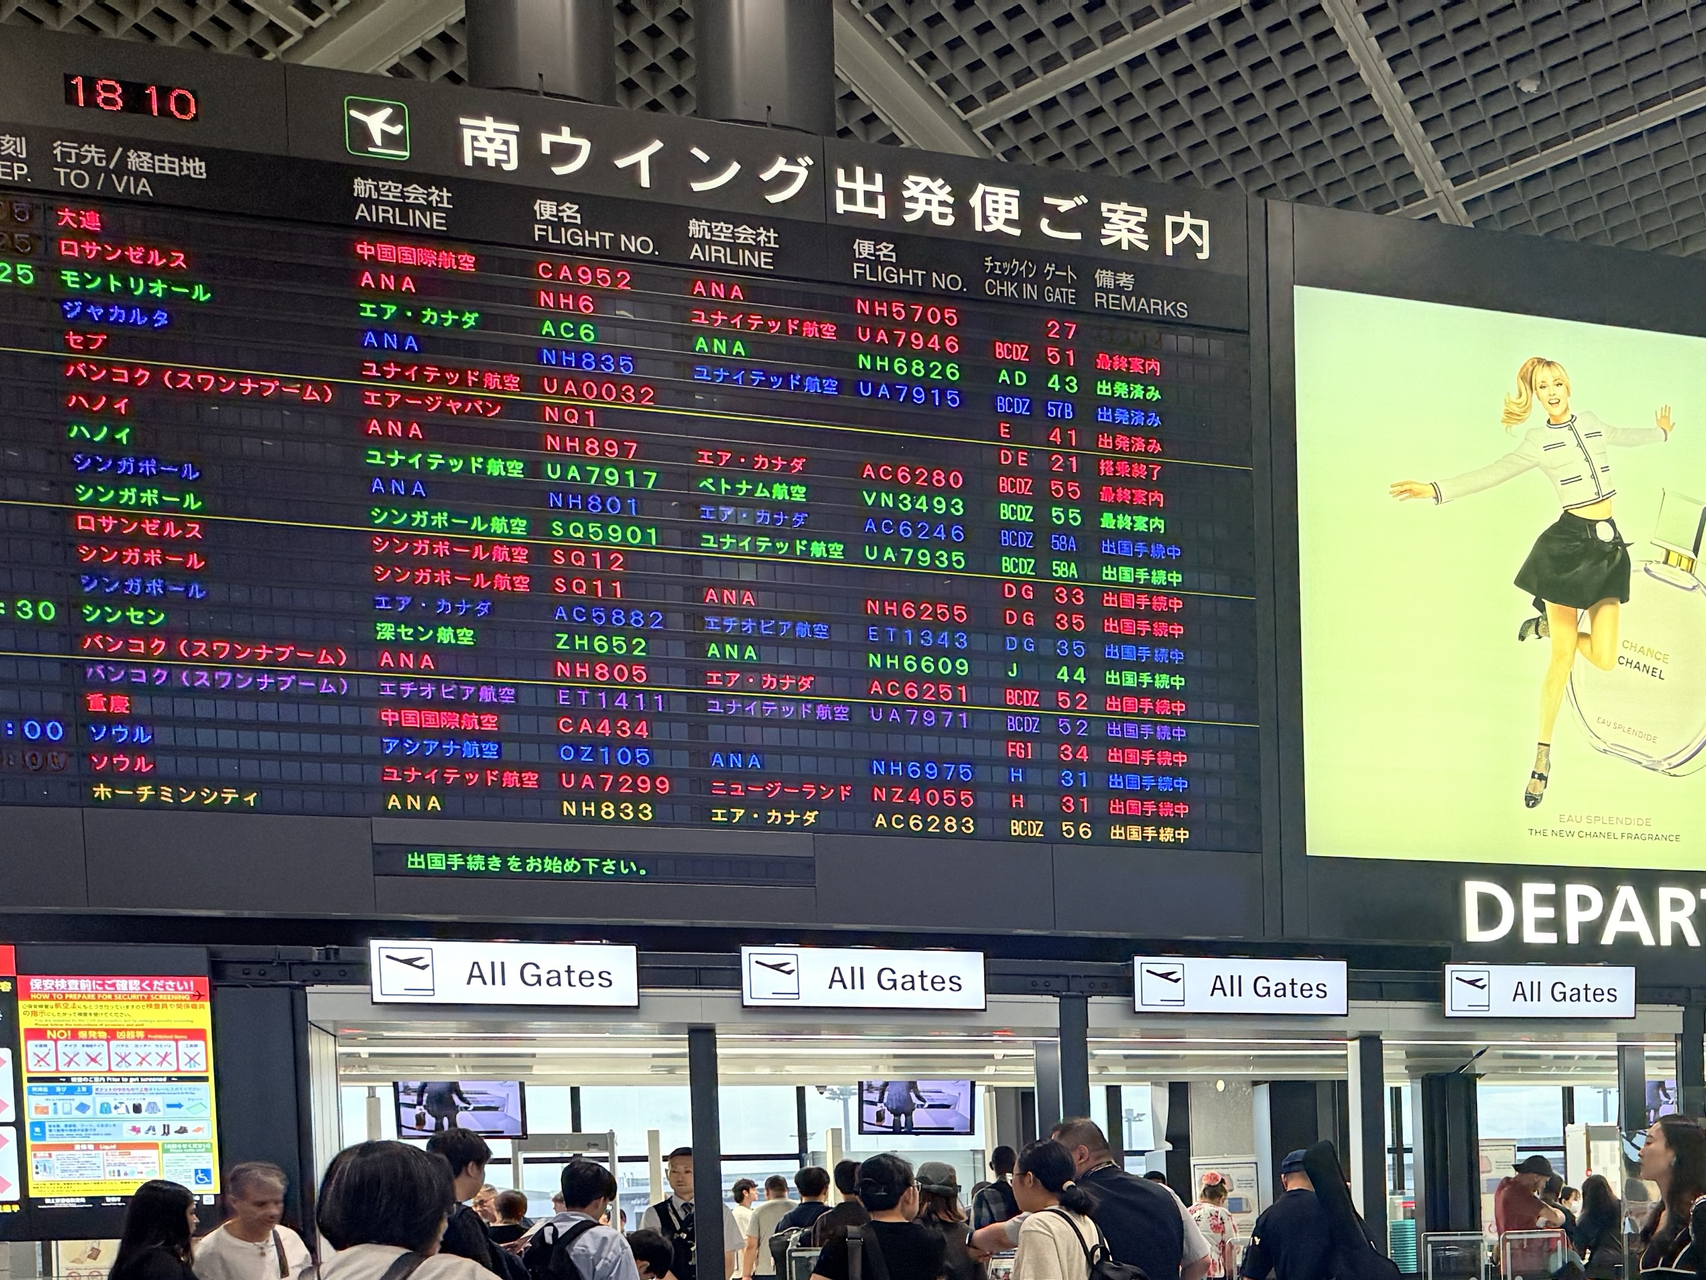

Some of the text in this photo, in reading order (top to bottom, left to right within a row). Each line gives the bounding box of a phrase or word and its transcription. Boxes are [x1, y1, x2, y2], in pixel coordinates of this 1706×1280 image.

[70, 76, 198, 120] 18 10
[53, 168, 153, 197] TO VIA
[353, 178, 453, 209] 航空会社
[459, 116, 1209, 260] 南ウイング出発便ご案内
[355, 206, 447, 231] AIRLINE
[534, 201, 582, 225] 便名
[534, 224, 660, 256] FLIGHT NO.
[58, 208, 1077, 340] 大連 中国国際航空 CA952 ANA NH5705 27
[984, 256, 1077, 281] チェックイン ゲート
[1094, 269, 1135, 291] 備考
[60, 240, 189, 269] ロサンゼルス
[361, 271, 416, 294] ANA
[539, 290, 596, 314] NH6
[691, 310, 836, 342] ユナイテッド航空
[857, 326, 960, 354] UA7946
[1046, 347, 1075, 367] 51
[985, 279, 1076, 305] CHK IN GATE
[1094, 292, 1189, 319] REMARKS
[61, 271, 212, 302] モントリオール
[359, 302, 481, 330] エア・カナダ
[541, 320, 597, 344] AC6
[694, 336, 746, 357] ANA
[858, 353, 961, 381] NH6826
[1048, 374, 1078, 394] 43
[1097, 380, 1162, 402] 出発済み
[69, 424, 131, 445] ハノイ
[365, 450, 524, 479] ユナイテッド航空
[547, 463, 658, 490] UA7917
[862, 490, 965, 516] VN3493
[1051, 506, 1082, 526] 55
[75, 484, 203, 511] シンガポール
[370, 506, 528, 537] シンガポール航空
[551, 520, 658, 546] SQ5901
[700, 533, 845, 560] ユナイテッド航空
[864, 545, 966, 570] UA7935
[1052, 561, 1078, 579] 58A
[1102, 565, 1183, 587] 出国手続中
[82, 604, 165, 626] シンセン
[556, 633, 647, 656] ZH652
[706, 642, 758, 661] ANA
[868, 653, 970, 676] NH6609
[1007, 662, 1019, 678] J
[1056, 665, 1087, 685] 44
[1105, 669, 1186, 690] 出国手続中
[1622, 639, 1670, 665] CHANCE
[1617, 655, 1665, 681] CHANEL
[93, 783, 258, 807] ホーチミンシティ
[387, 794, 442, 812] ANA
[562, 800, 653, 821] NH833
[711, 808, 820, 827] エア・カナダ
[874, 813, 975, 834] AC6283
[1061, 822, 1092, 840] 56
[1110, 825, 1190, 844] 出国手続中
[1528, 828, 1681, 842] THE NEW CHANEL FRAGRANCE
[407, 852, 649, 876] 出国手続きをお始め下さい。
[467, 961, 614, 990] All Gates
[828, 966, 963, 994] All Gates
[1210, 975, 1328, 1000] All Gates
[1512, 980, 1618, 1004] All Gates
